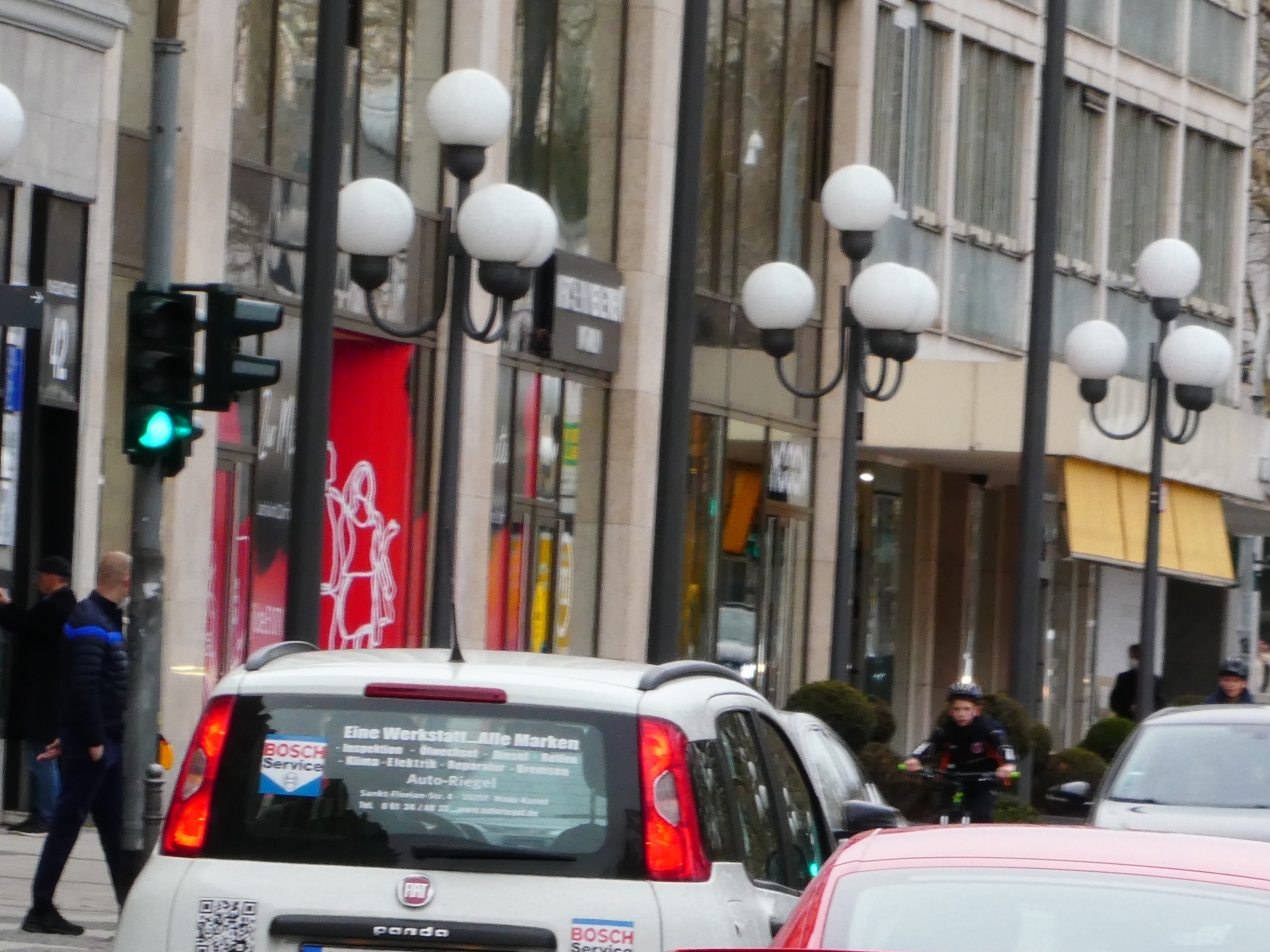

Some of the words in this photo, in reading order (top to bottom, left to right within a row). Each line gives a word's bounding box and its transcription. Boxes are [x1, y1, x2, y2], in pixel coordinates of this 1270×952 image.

[344, 726, 380, 740] Eine
[514, 733, 580, 750] Marken
[263, 743, 327, 758] BOSCH
[262, 757, 325, 772] Service
[387, 757, 438, 769] Elektrik
[406, 773, 497, 789] Auto-Riegel
[403, 882, 429, 898] FIAT
[373, 925, 449, 938] panda
[571, 926, 635, 945] BOSCH
